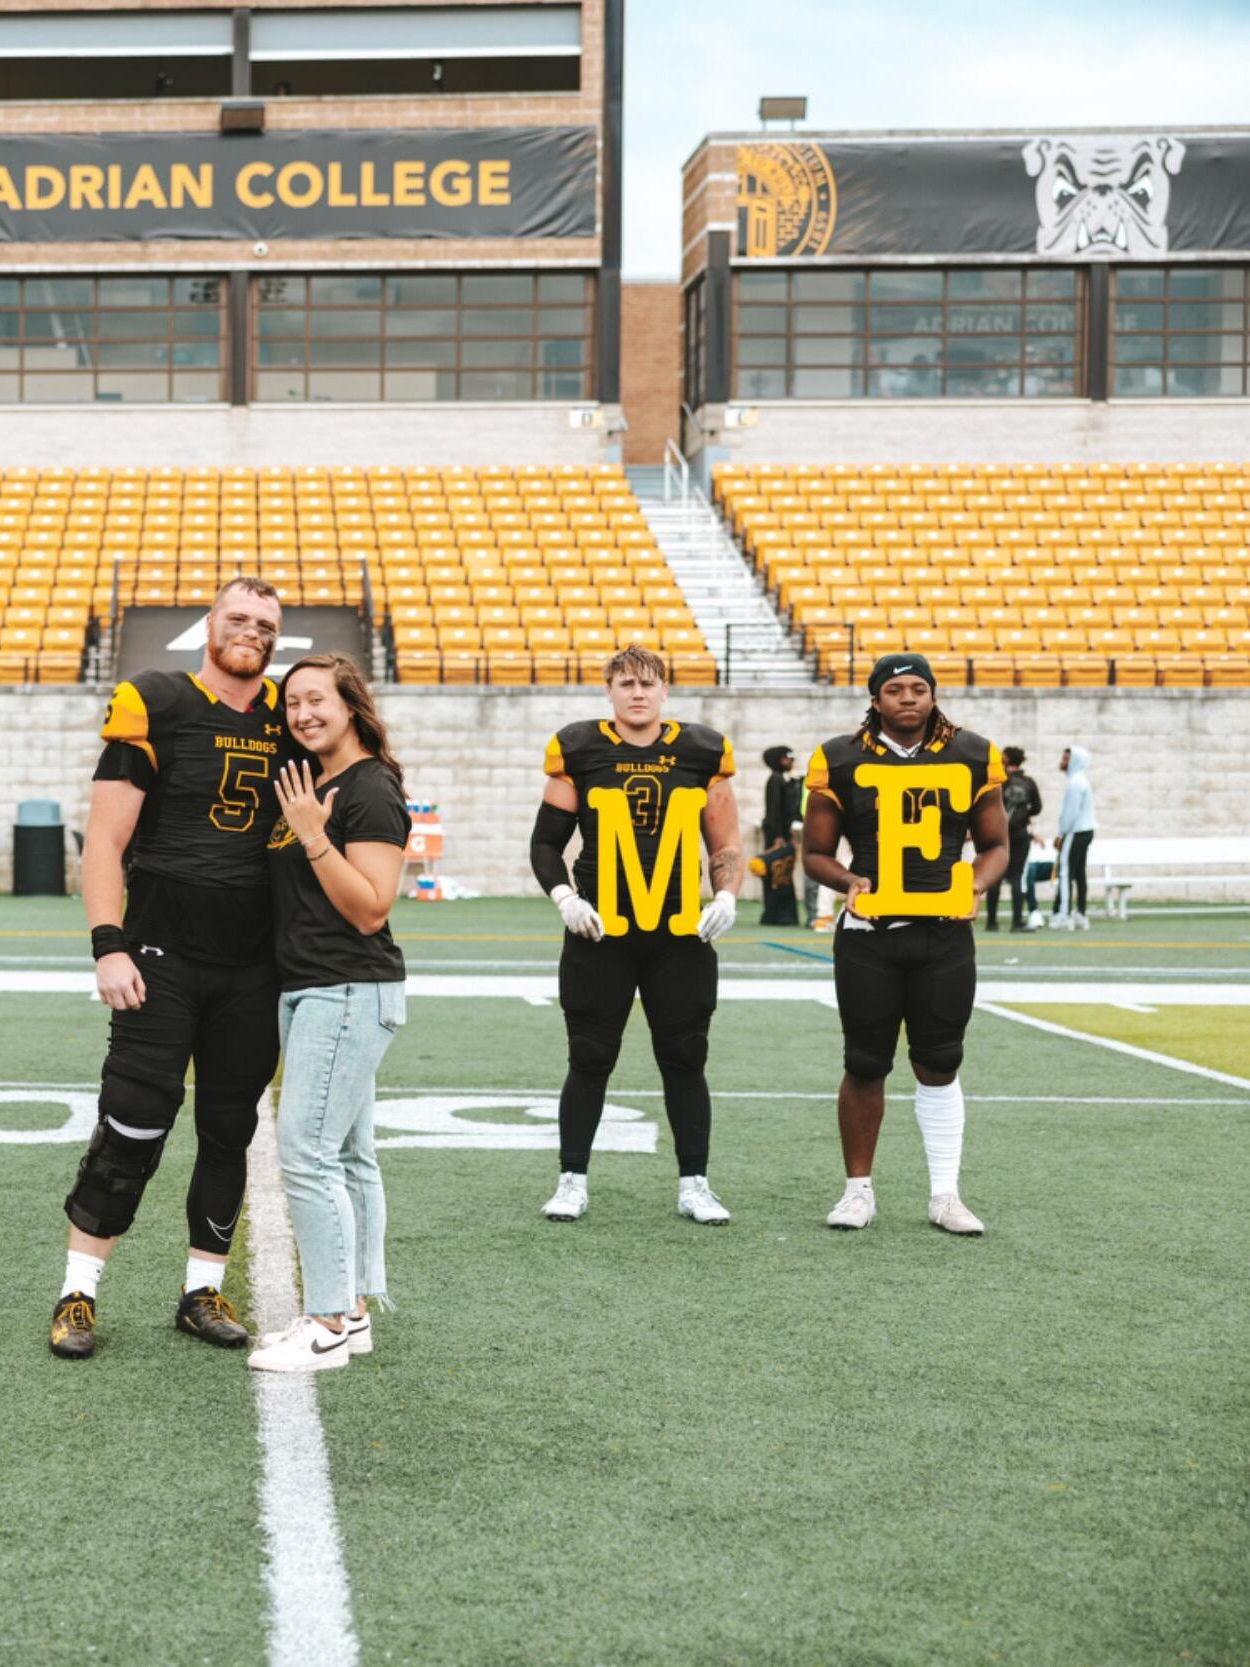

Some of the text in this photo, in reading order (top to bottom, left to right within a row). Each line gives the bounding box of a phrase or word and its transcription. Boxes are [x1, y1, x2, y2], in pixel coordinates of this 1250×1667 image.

[235, 160, 512, 210] COLLEGE
[214, 735, 278, 755] BULLDOGS
[615, 762, 671, 774] BULLDOGS
[208, 751, 269, 833] 5
